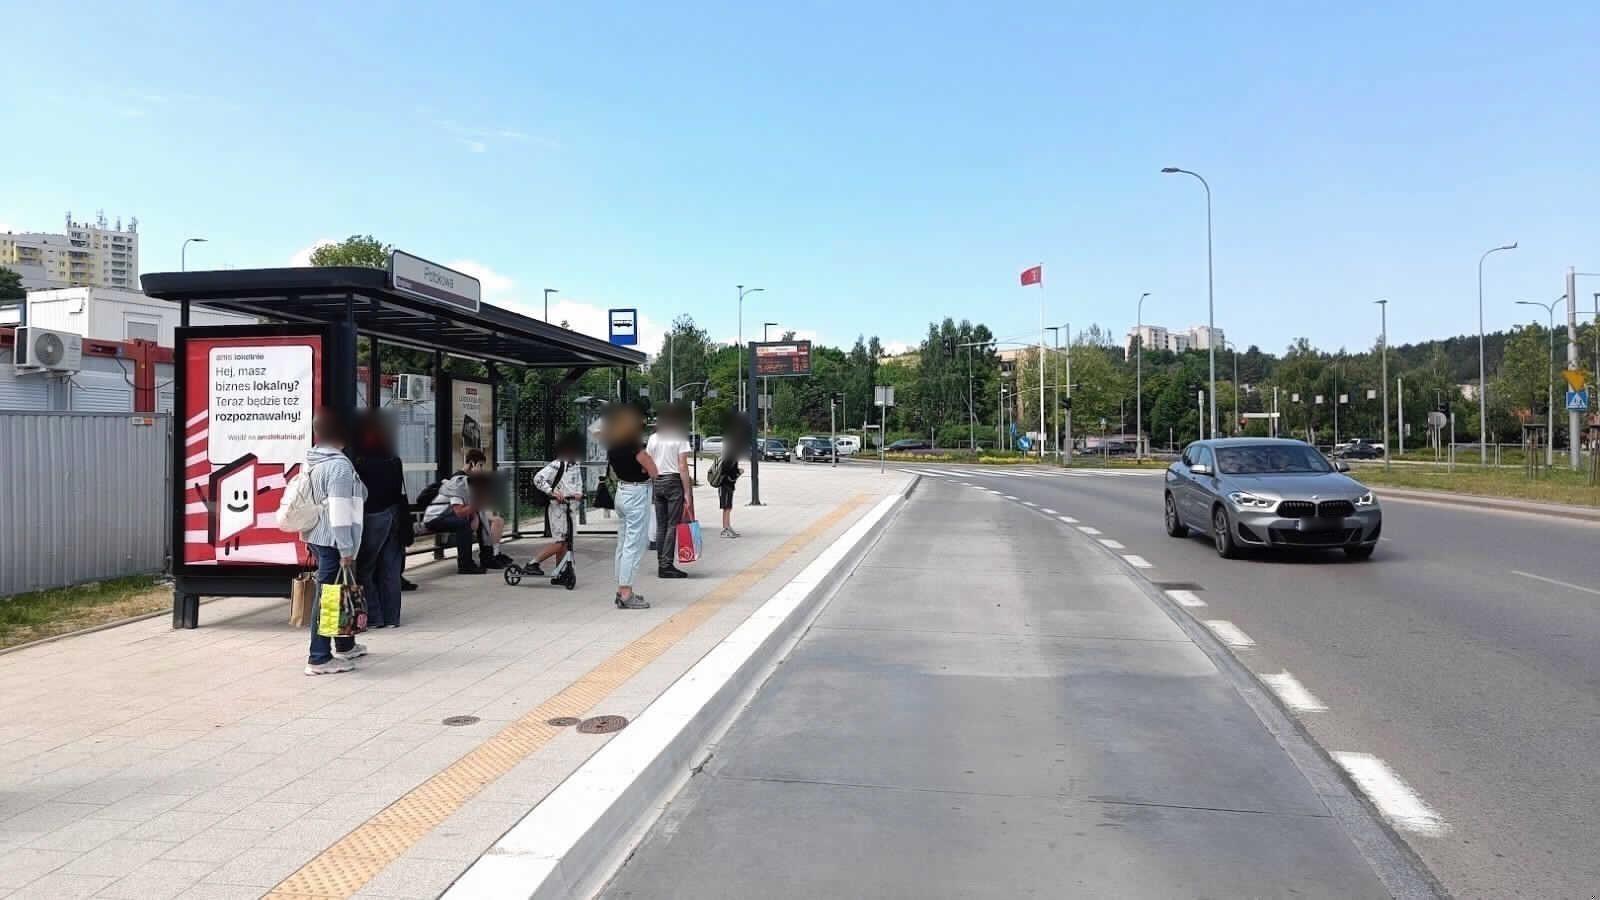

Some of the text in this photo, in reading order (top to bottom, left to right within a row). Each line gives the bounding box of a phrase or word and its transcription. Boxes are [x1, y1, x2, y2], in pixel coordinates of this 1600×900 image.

[216, 366, 267, 378] Hej, masz
[215, 380, 300, 393] biznes lokalny?
[216, 395, 300, 408] Teraz będzie też
[215, 410, 301, 423] rozpoznawalny!
